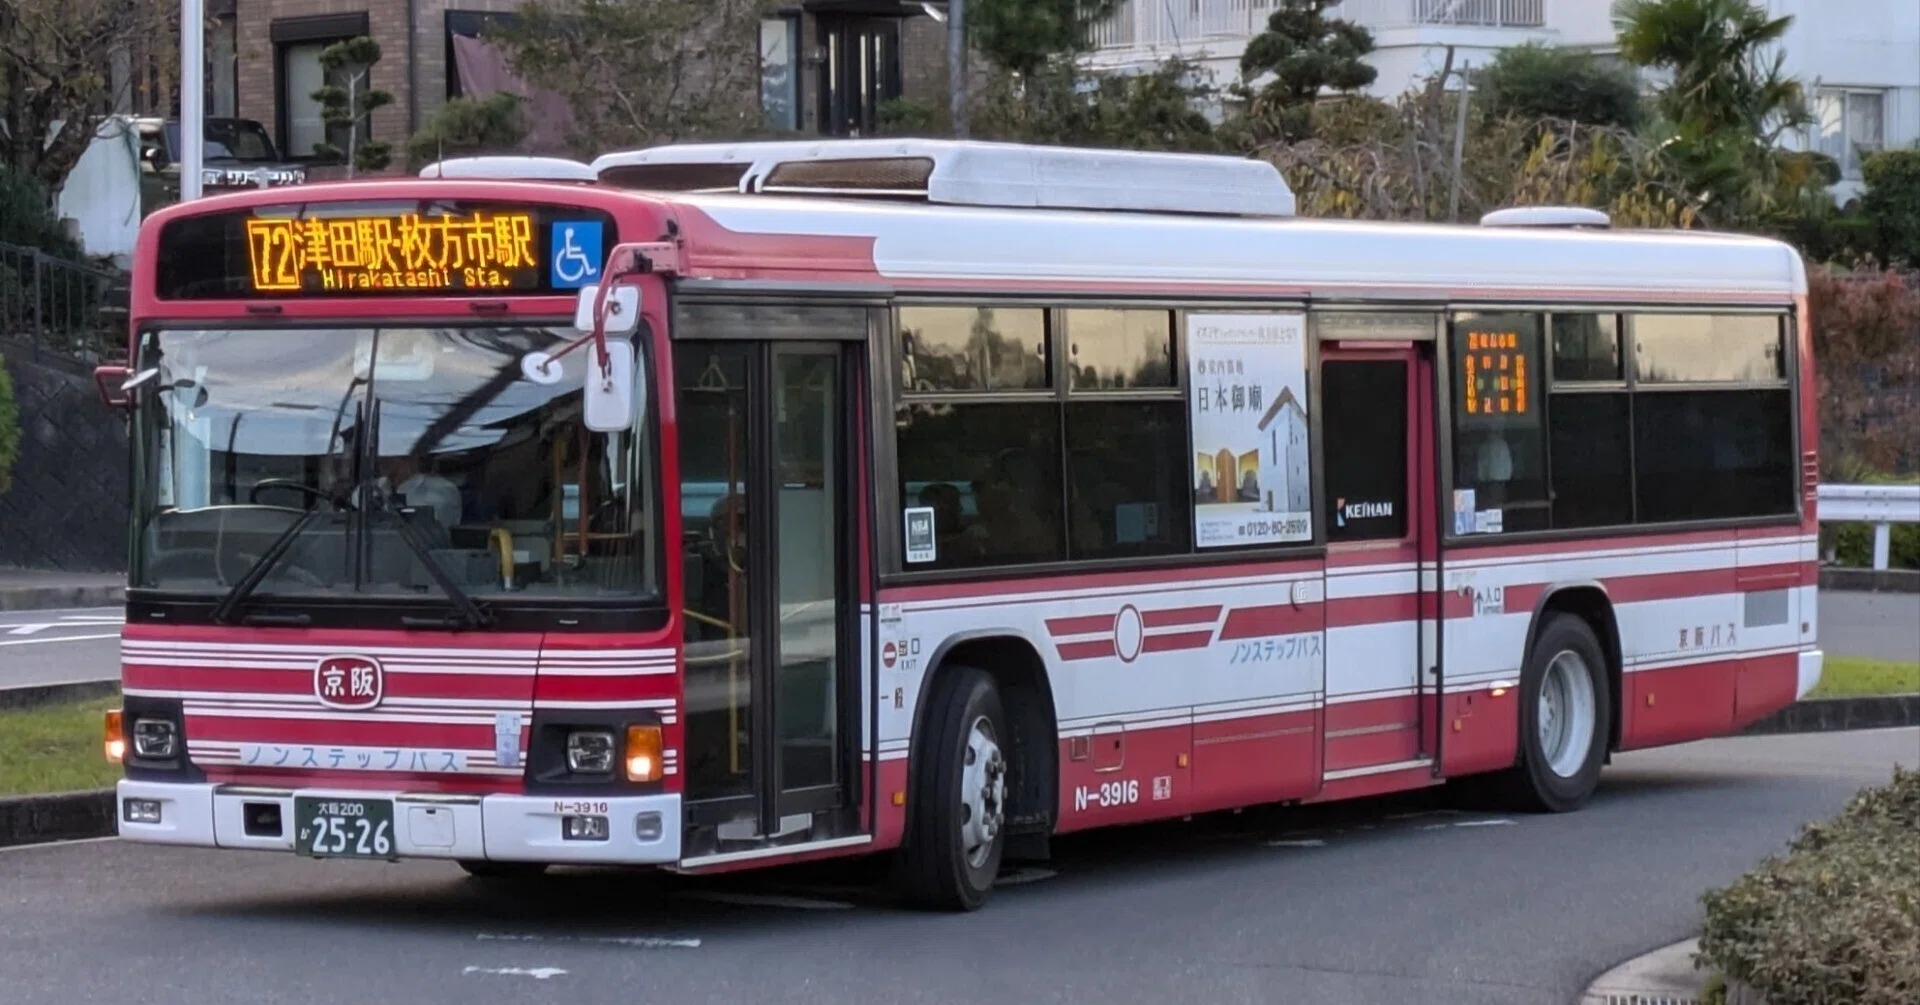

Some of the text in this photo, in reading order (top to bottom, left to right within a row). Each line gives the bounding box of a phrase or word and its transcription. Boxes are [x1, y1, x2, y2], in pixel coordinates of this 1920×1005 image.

[252, 227, 295, 284] 72
[324, 267, 510, 288] Hirakatashi Sta.
[1345, 502, 1393, 519] KEIHAN
[899, 638, 920, 656] 出口
[1678, 622, 1737, 648] 京阪バス
[1229, 635, 1322, 665] ノンステップバス
[901, 659, 917, 671] EXIT
[322, 664, 375, 697] 京阪
[246, 746, 460, 772] ノンステップバス
[1075, 779, 1139, 811] N-3916
[312, 816, 390, 854] 25-26
